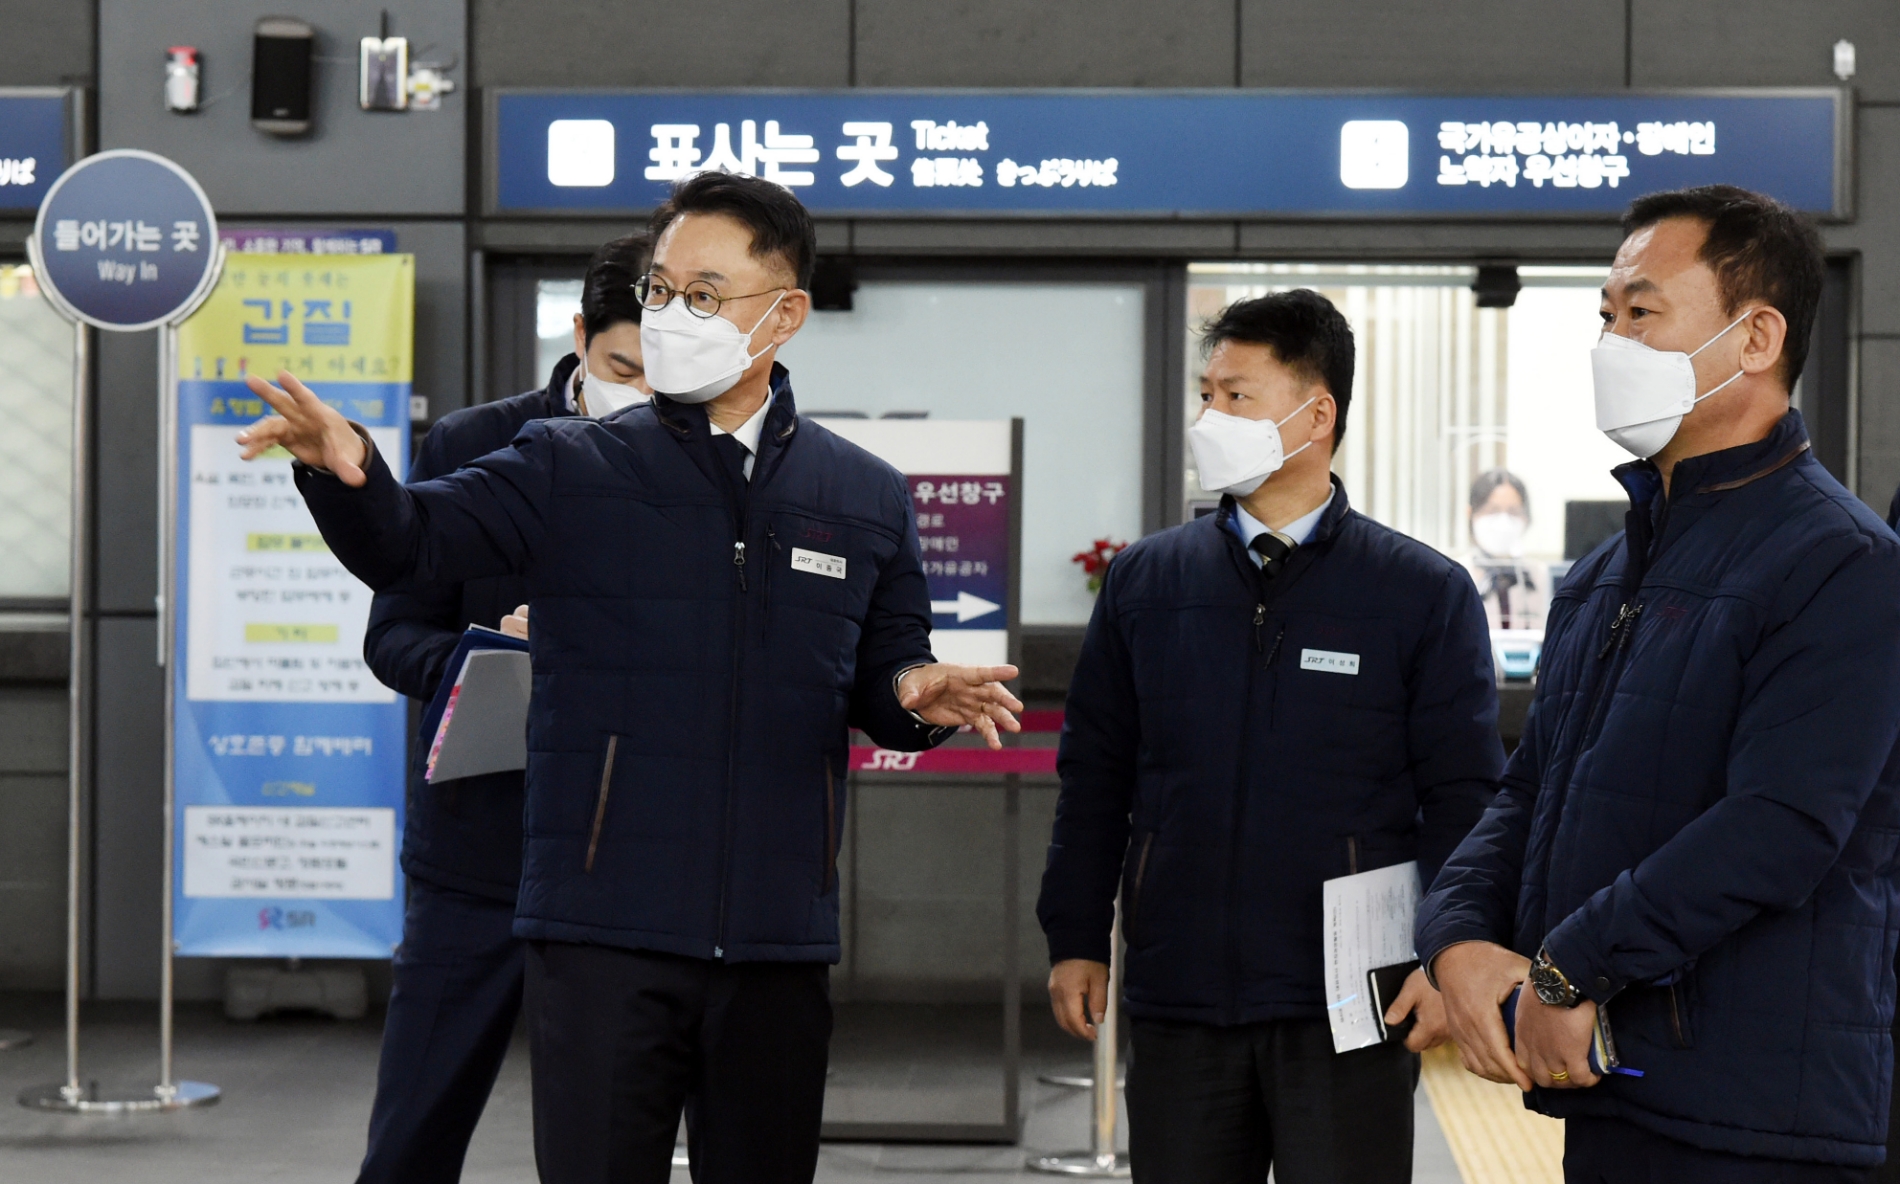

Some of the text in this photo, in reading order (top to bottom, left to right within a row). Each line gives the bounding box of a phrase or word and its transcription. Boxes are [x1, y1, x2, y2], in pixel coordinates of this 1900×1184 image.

[910, 119, 990, 151] Ticket
[644, 119, 899, 187] 표사는 곳
[1437, 153, 1630, 188] 노약자 우선창구
[53, 219, 163, 251] 들어가는
[171, 220, 200, 251] 곳
[97, 259, 159, 286] Way In
[242, 298, 352, 346] 갑질
[914, 481, 1005, 504] 우선창구
[916, 513, 945, 529] 경로
[794, 556, 813, 565] SRT
[1304, 656, 1326, 664] SRT
[860, 749, 923, 770] SRT
